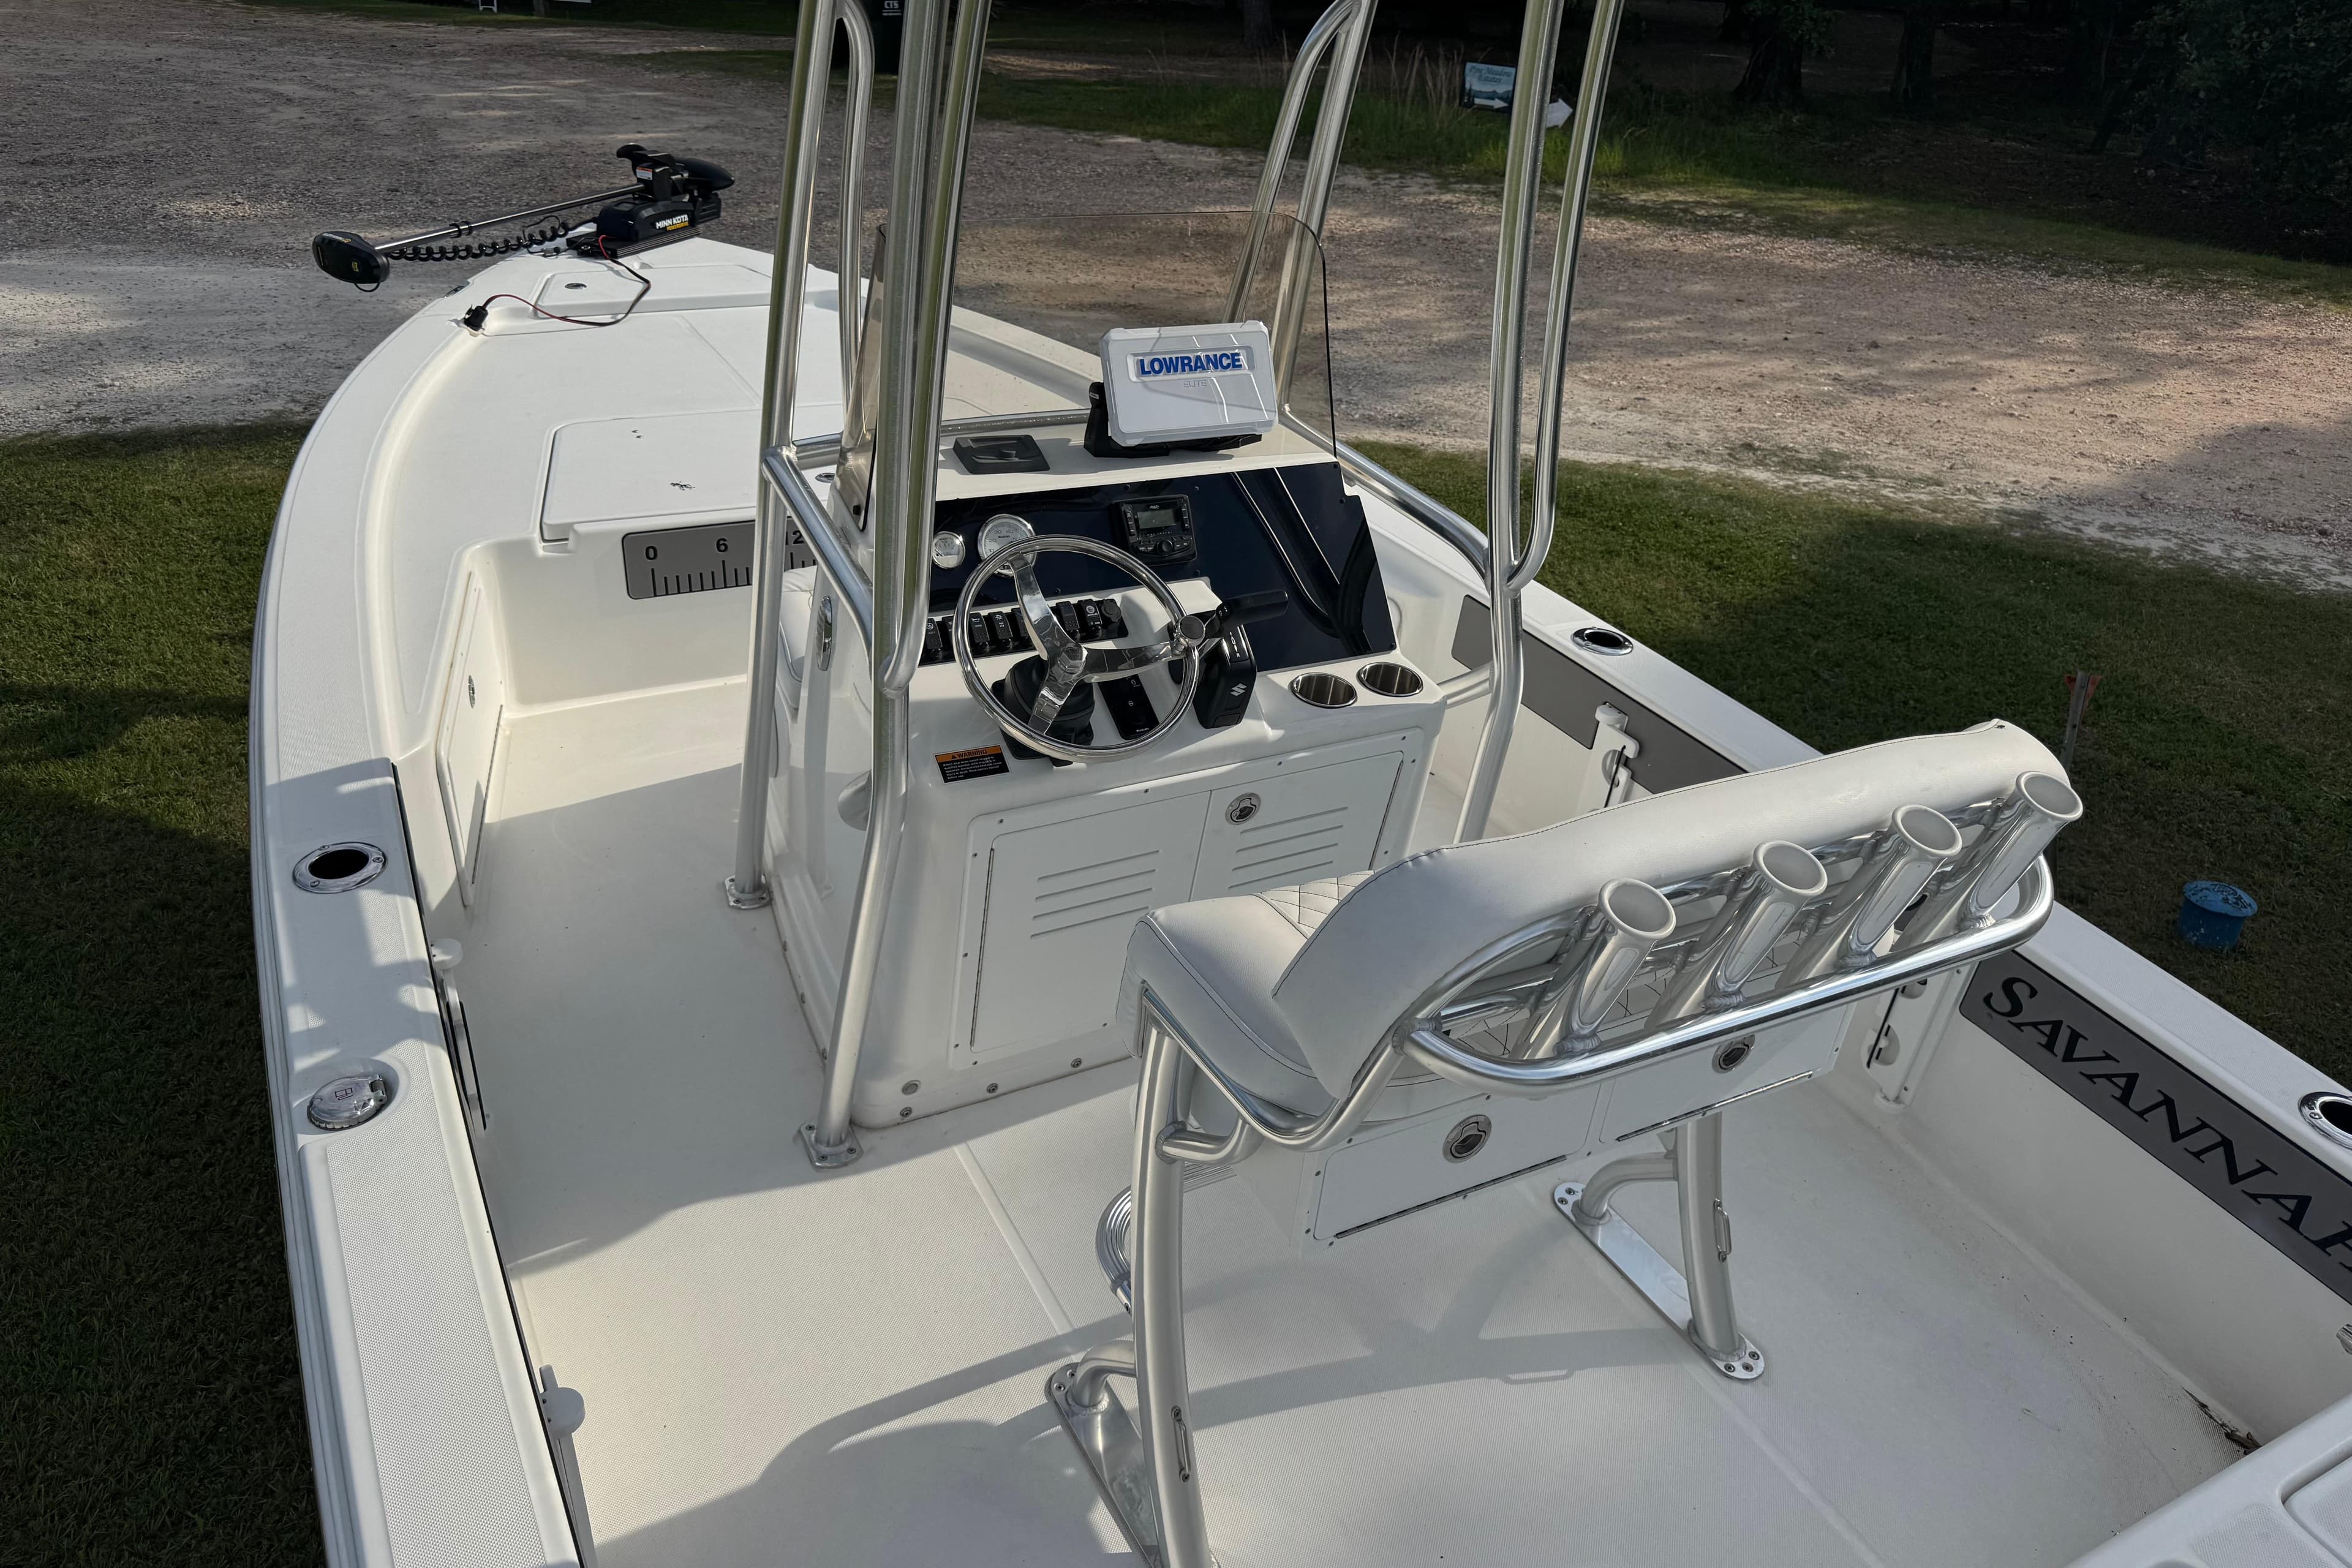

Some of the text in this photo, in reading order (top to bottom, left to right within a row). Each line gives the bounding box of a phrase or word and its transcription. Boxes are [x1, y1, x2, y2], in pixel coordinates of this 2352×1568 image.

[655, 214, 689, 229] MINN KOTA
[1139, 352, 1243, 375] LOWRANCE
[645, 545, 658, 560] 0
[716, 538, 728, 552] 6
[957, 749, 988, 759] WARNING
